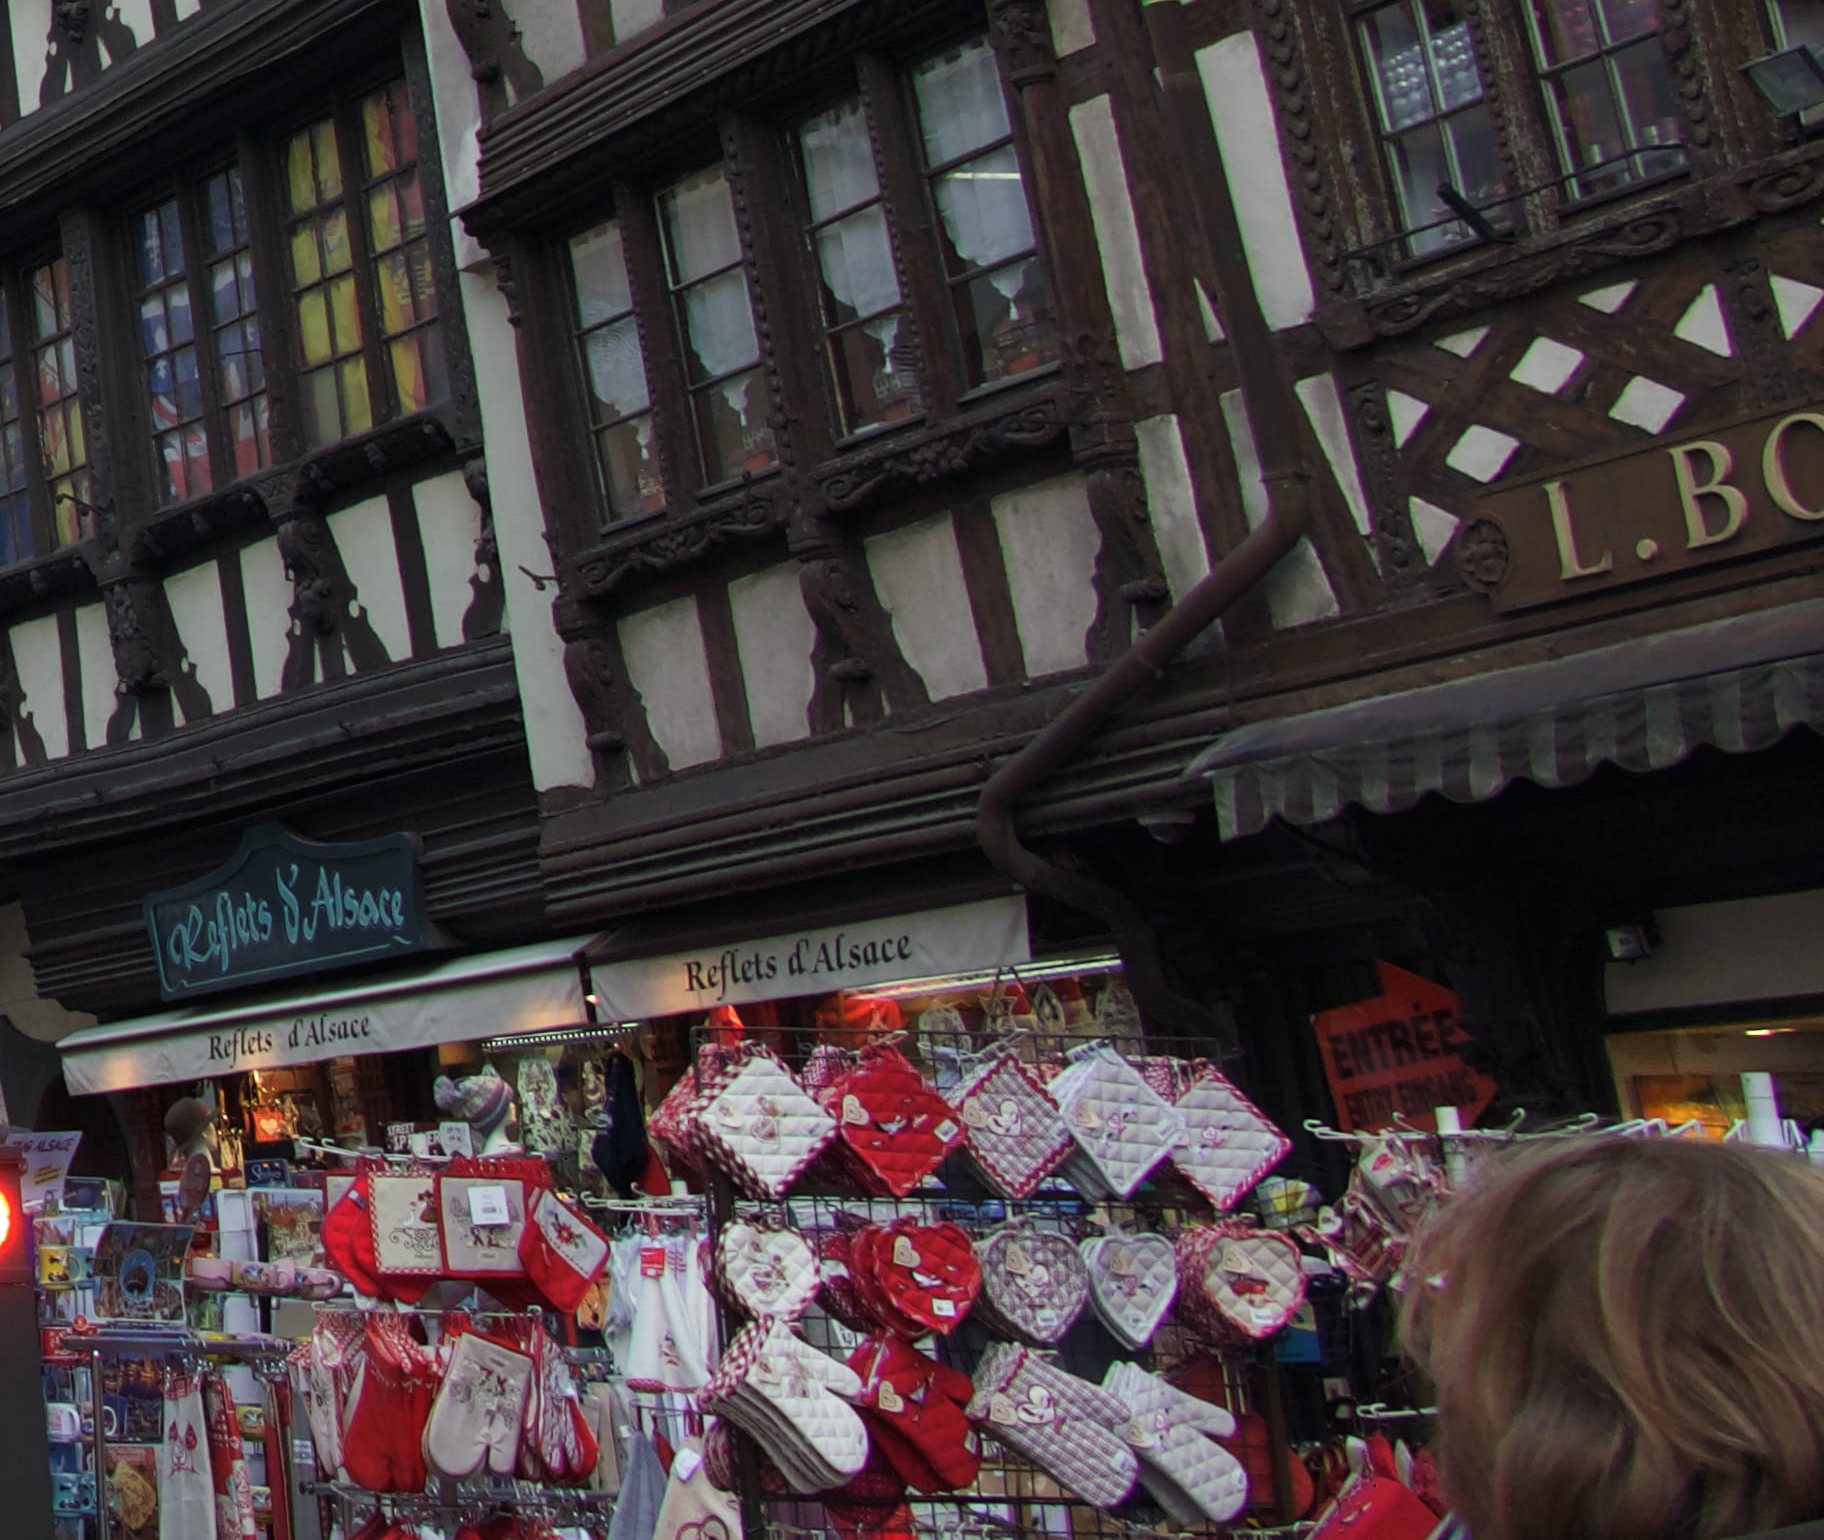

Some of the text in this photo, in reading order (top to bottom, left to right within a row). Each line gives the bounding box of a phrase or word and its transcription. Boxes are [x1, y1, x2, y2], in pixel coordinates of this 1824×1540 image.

[168, 891, 272, 973] Reflets
[685, 932, 913, 1001] Reflets d'Alsace
[208, 1013, 370, 1069] Reflets d'Alsace
[1328, 1003, 1456, 1079] ENTRÉE
